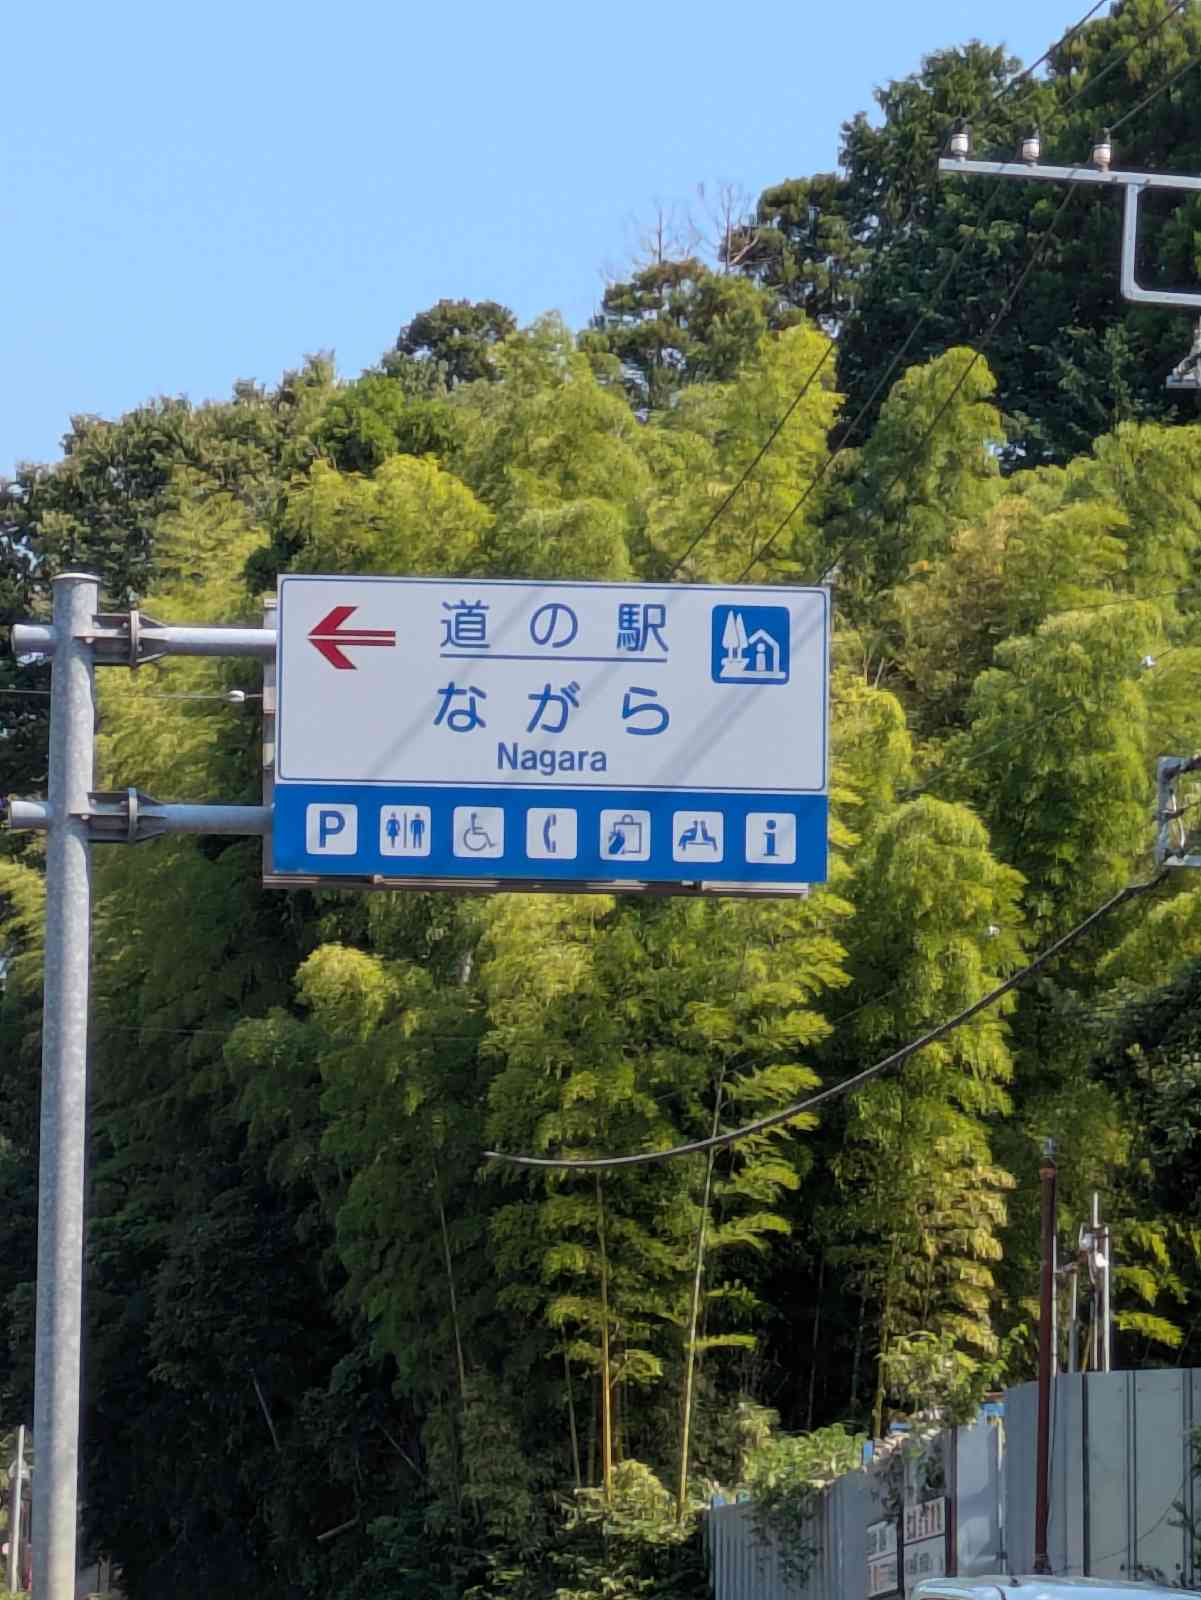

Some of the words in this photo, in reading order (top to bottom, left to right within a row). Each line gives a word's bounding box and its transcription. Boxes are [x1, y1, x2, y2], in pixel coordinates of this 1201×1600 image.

[440, 600, 669, 652] 道の駅
[433, 681, 670, 736] ながら
[497, 743, 608, 776] Nagara
[319, 810, 346, 848] P
